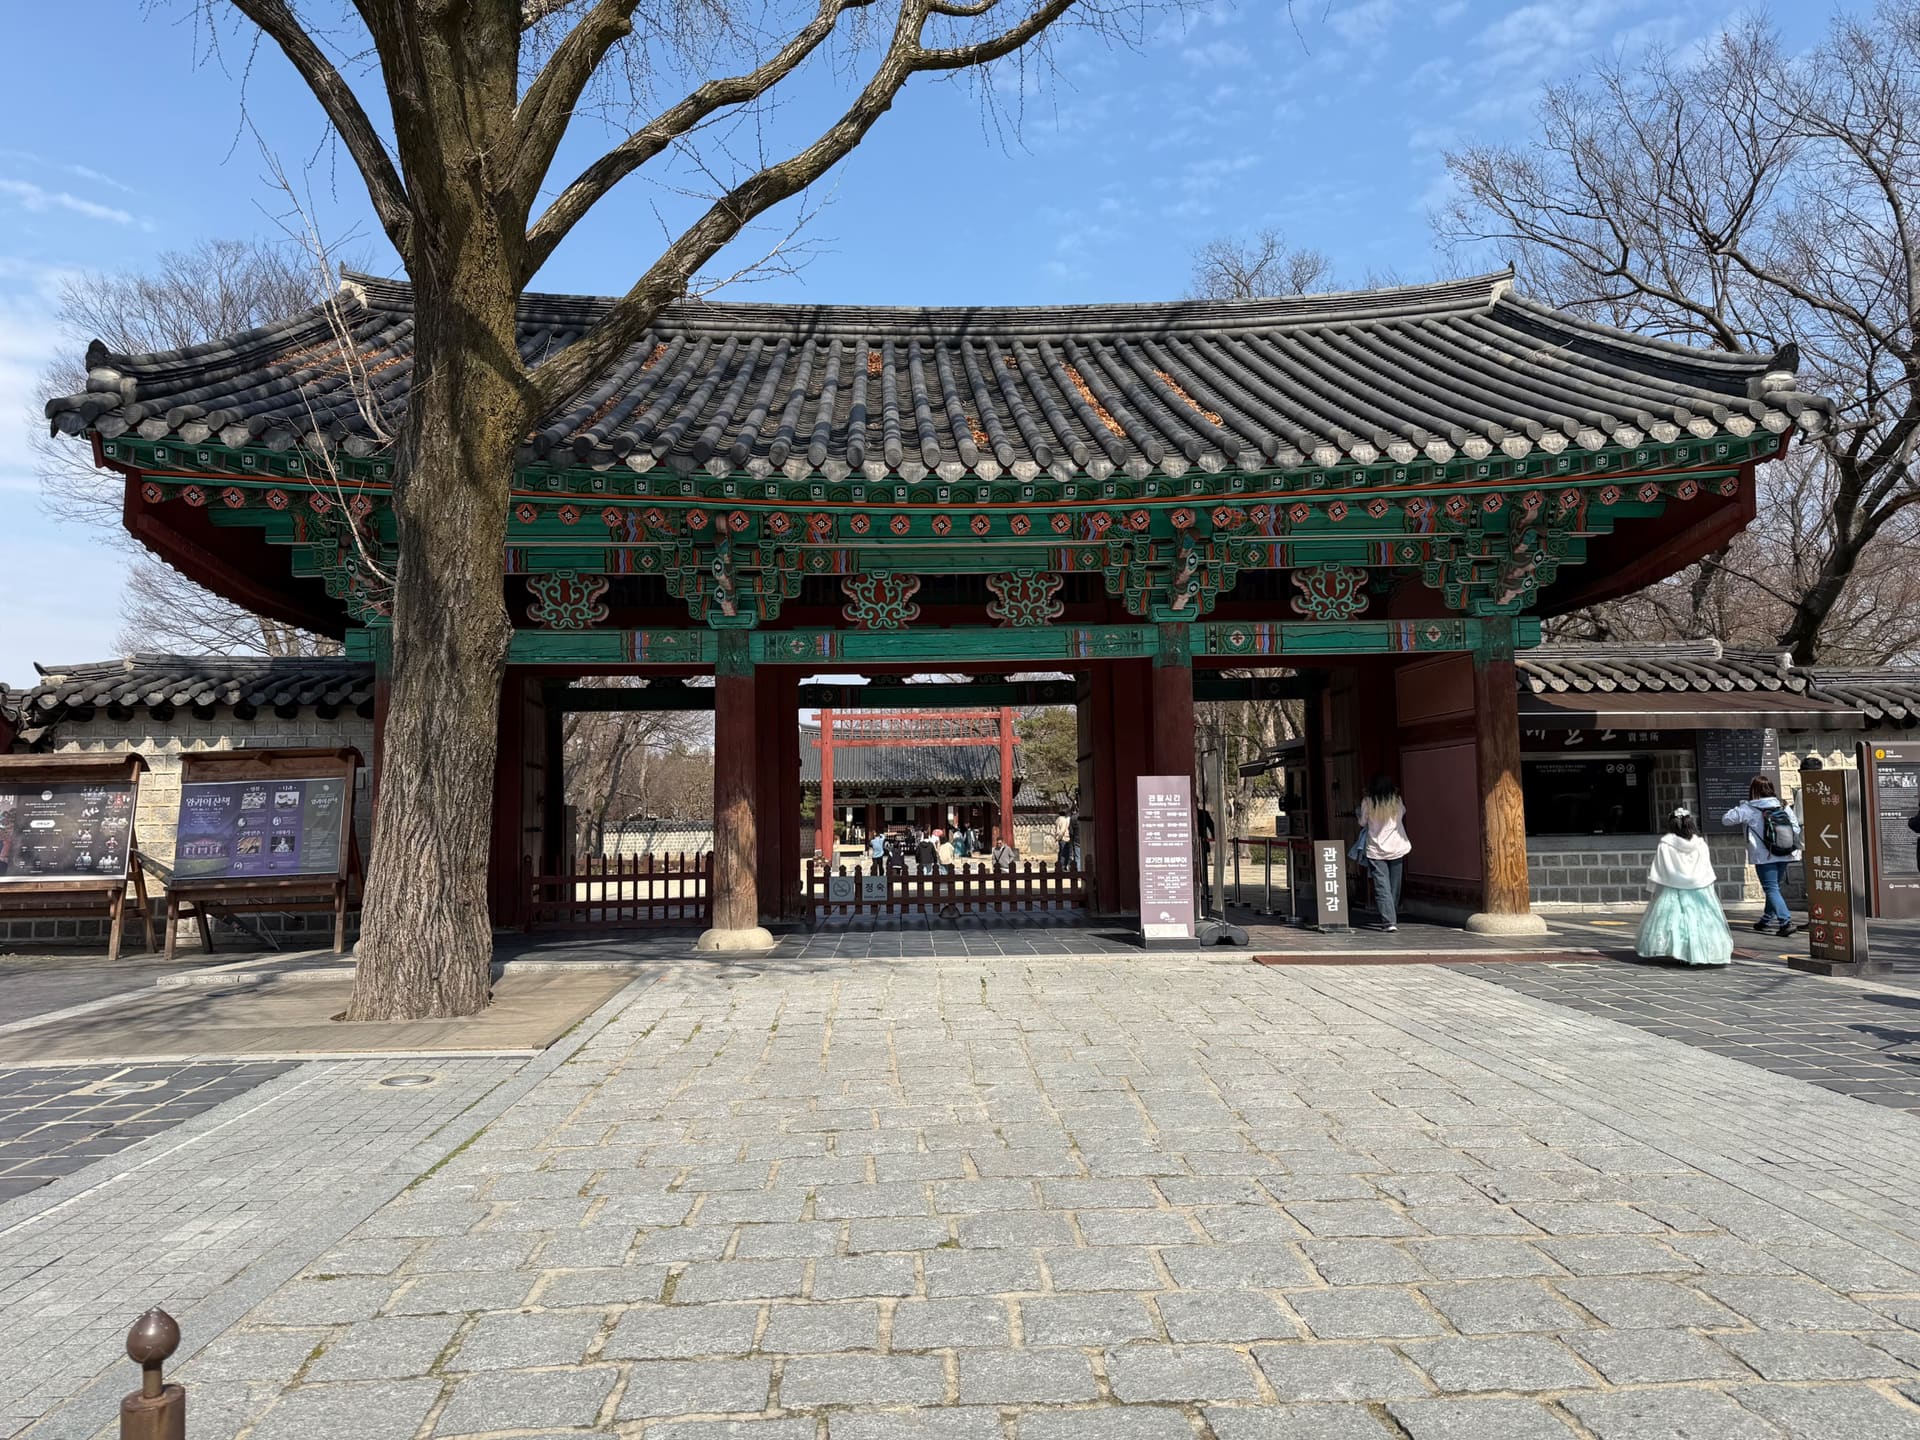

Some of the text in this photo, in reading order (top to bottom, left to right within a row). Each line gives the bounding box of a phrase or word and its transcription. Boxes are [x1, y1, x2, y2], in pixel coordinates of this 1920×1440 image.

[1148, 794, 1181, 802] 관람시간
[1813, 855, 1841, 867] 매표소
[1323, 847, 1340, 911] 관람마감
[1813, 868, 1842, 880] TICKET
